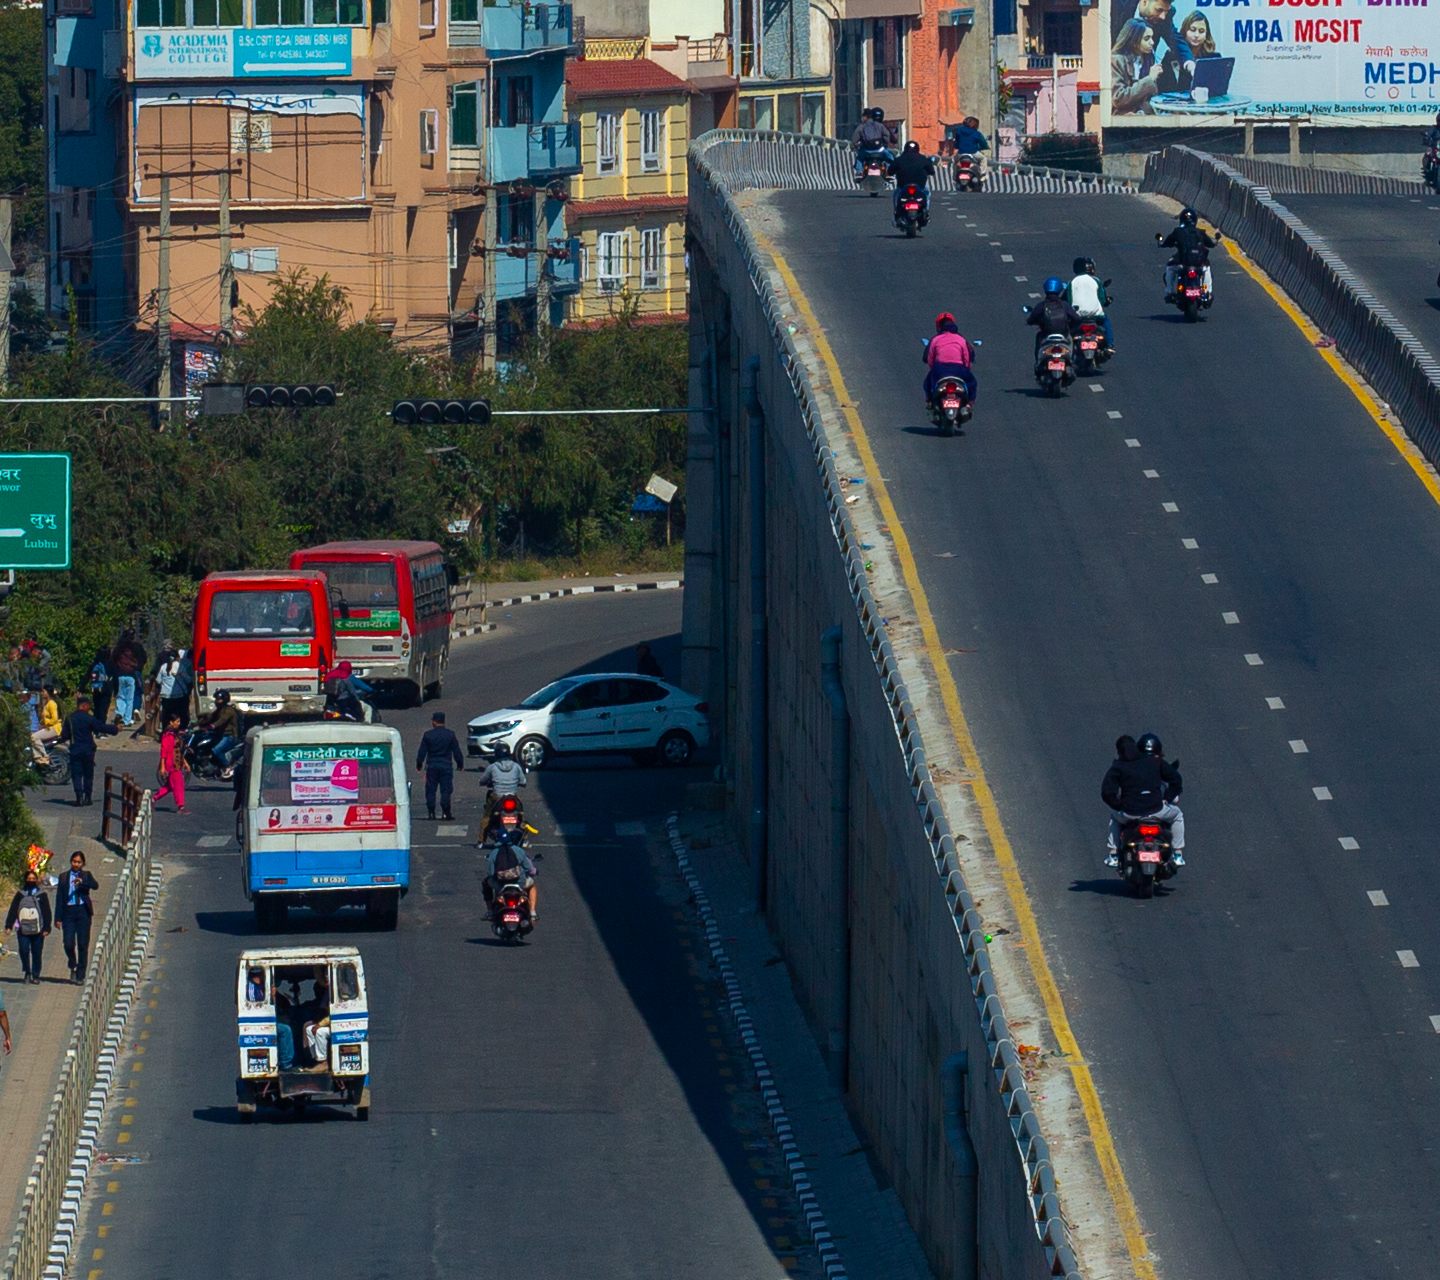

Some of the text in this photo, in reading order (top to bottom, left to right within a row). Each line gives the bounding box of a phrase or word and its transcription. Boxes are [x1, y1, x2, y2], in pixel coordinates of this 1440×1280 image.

[1234, 19, 1363, 42] MBA MCSIT
[168, 34, 228, 46] ACADEMIA
[169, 55, 228, 63] COLLEGE
[1311, 104, 1332, 113] New
[1334, 103, 1387, 114] Baneshwor,
[1390, 103, 1405, 112] Tel:
[30, 513, 57, 530] लुभु
[24, 539, 58, 549] Lubhu
